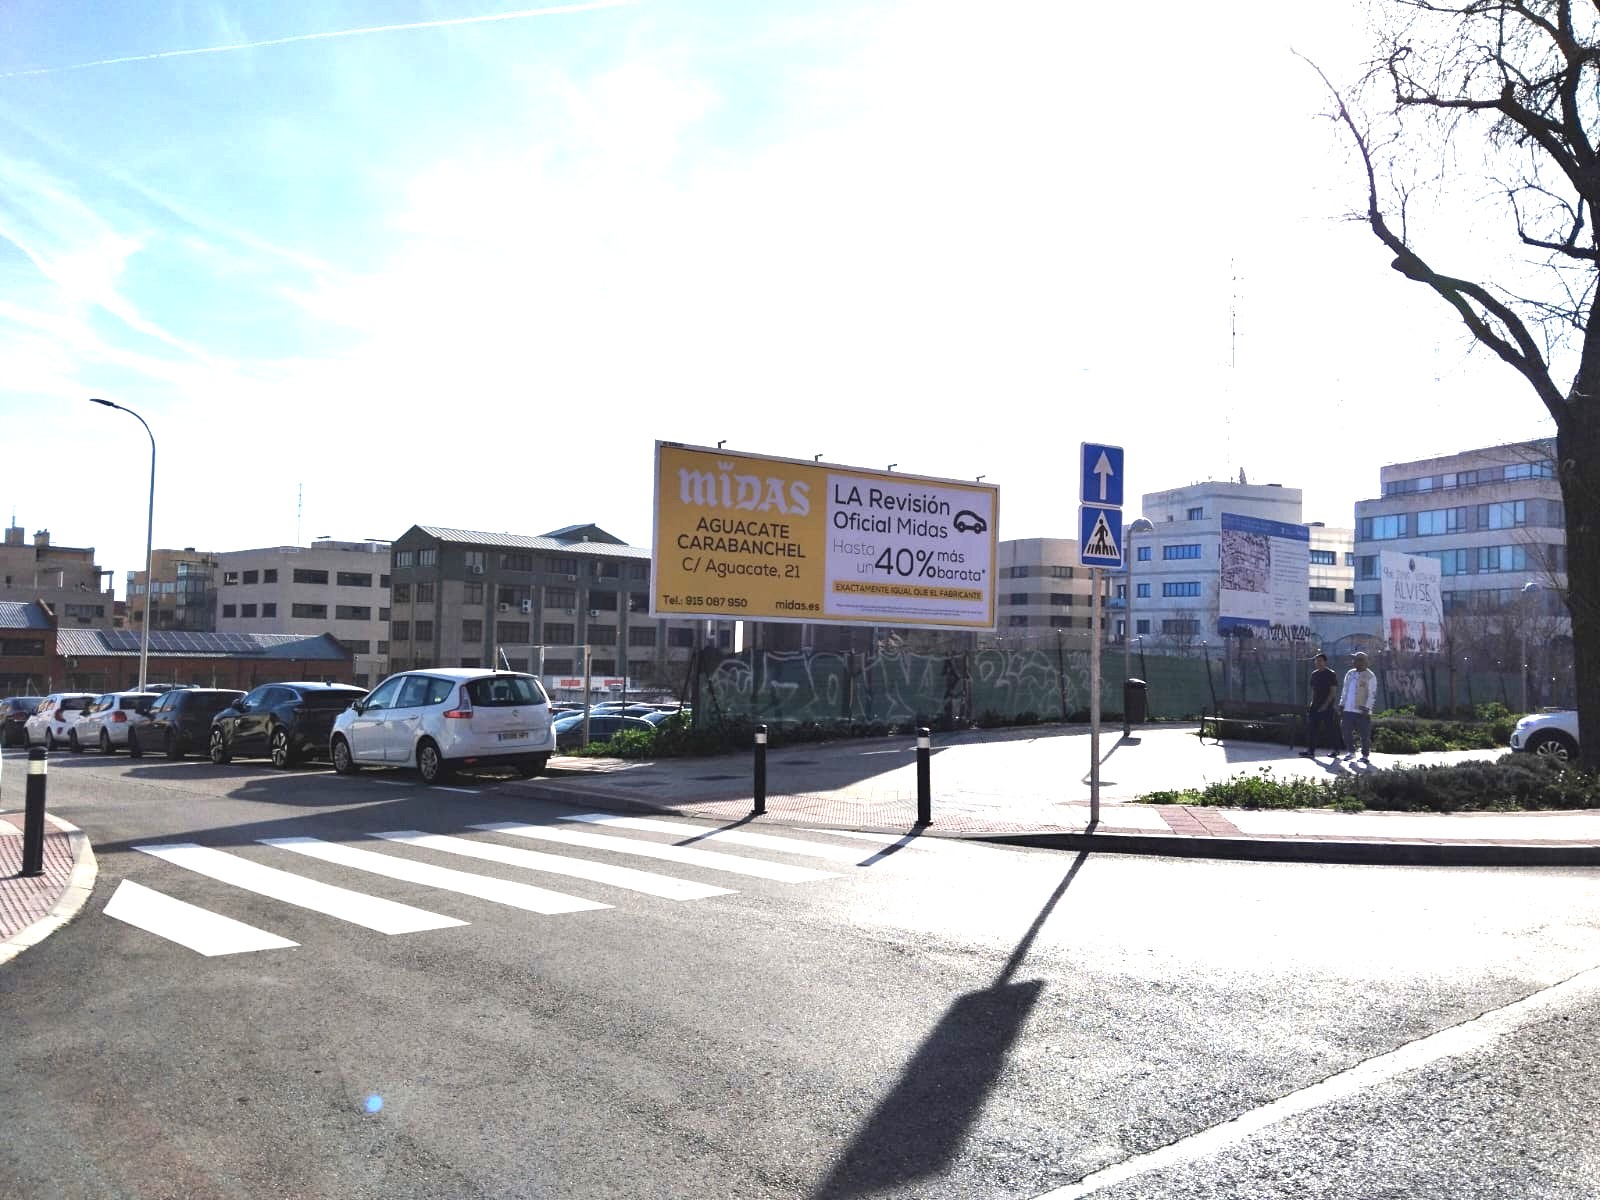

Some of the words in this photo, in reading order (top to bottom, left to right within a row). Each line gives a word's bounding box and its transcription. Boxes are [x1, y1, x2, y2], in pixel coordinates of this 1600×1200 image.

[834, 484, 863, 507] LA
[869, 488, 950, 516] Revisión
[696, 517, 790, 539] AGUACATE
[833, 511, 891, 533] Oficial
[897, 517, 949, 538] Midas
[677, 534, 806, 558] CARABANCHEL
[833, 538, 875, 556] Hasta
[937, 550, 965, 563] más
[682, 556, 702, 573] C/
[705, 559, 781, 578] Aguacate,
[785, 564, 801, 578] 21
[856, 561, 874, 574] un
[874, 547, 937, 578] 40%
[685, 595, 704, 606] 915
[706, 596, 726, 607] 087
[727, 598, 748, 608] 950
[835, 583, 889, 594] EXACTAMENTE
[890, 586, 912, 595] IGUAL
[913, 587, 929, 596] QUE
[929, 588, 938, 597] EL
[939, 589, 982, 600] FABRICANTE
[775, 600, 820, 611] midas.es
